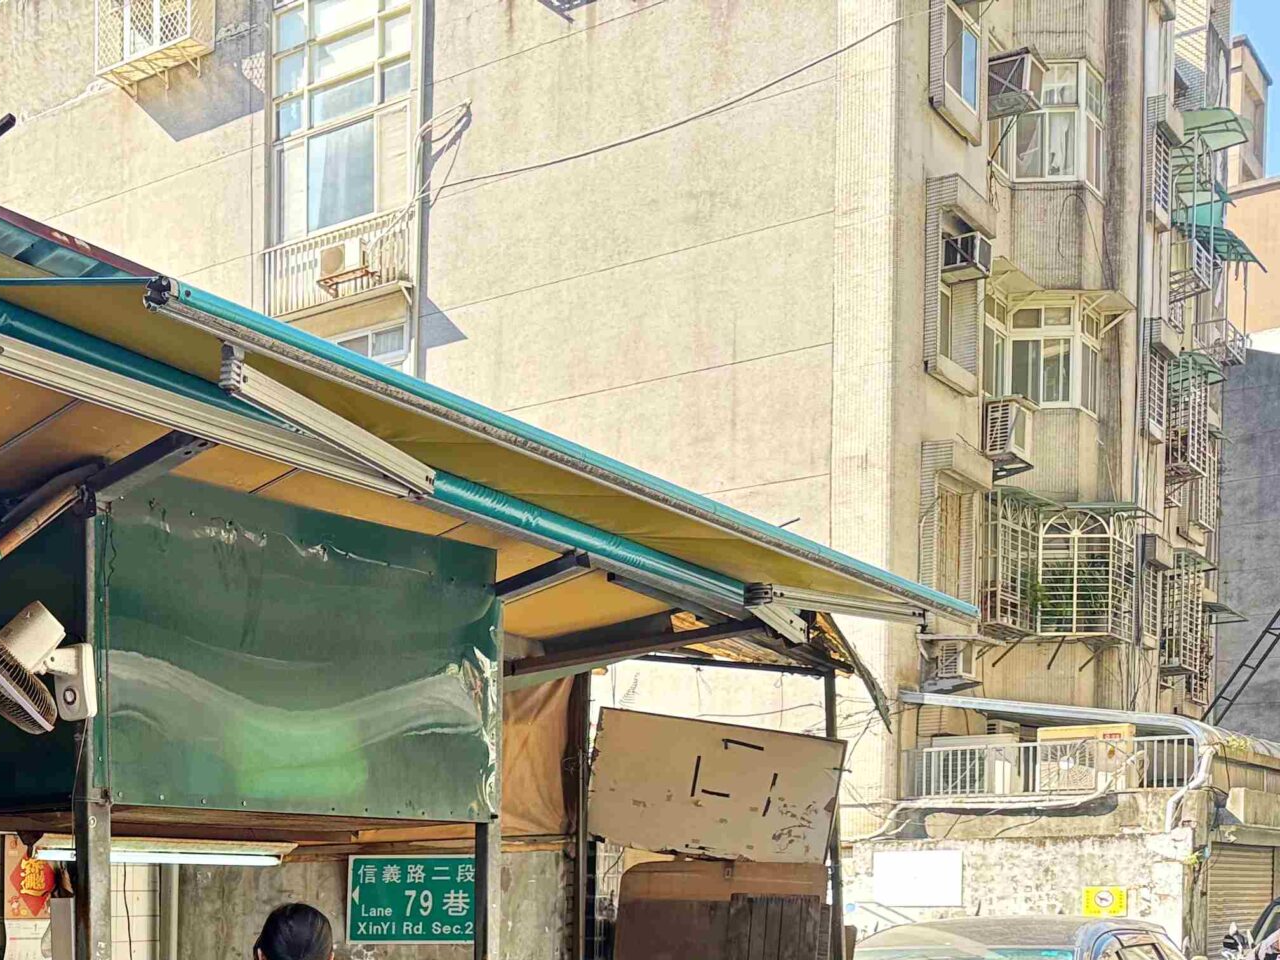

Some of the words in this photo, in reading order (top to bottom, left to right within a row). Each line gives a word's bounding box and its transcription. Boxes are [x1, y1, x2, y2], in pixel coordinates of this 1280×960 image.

[357, 864, 475, 884] 信義路二段
[361, 904, 392, 917] Lane
[404, 889, 433, 917] 79
[442, 889, 470, 916] 巷
[403, 921, 426, 935] Rd.
[431, 921, 474, 935] Sec.2
